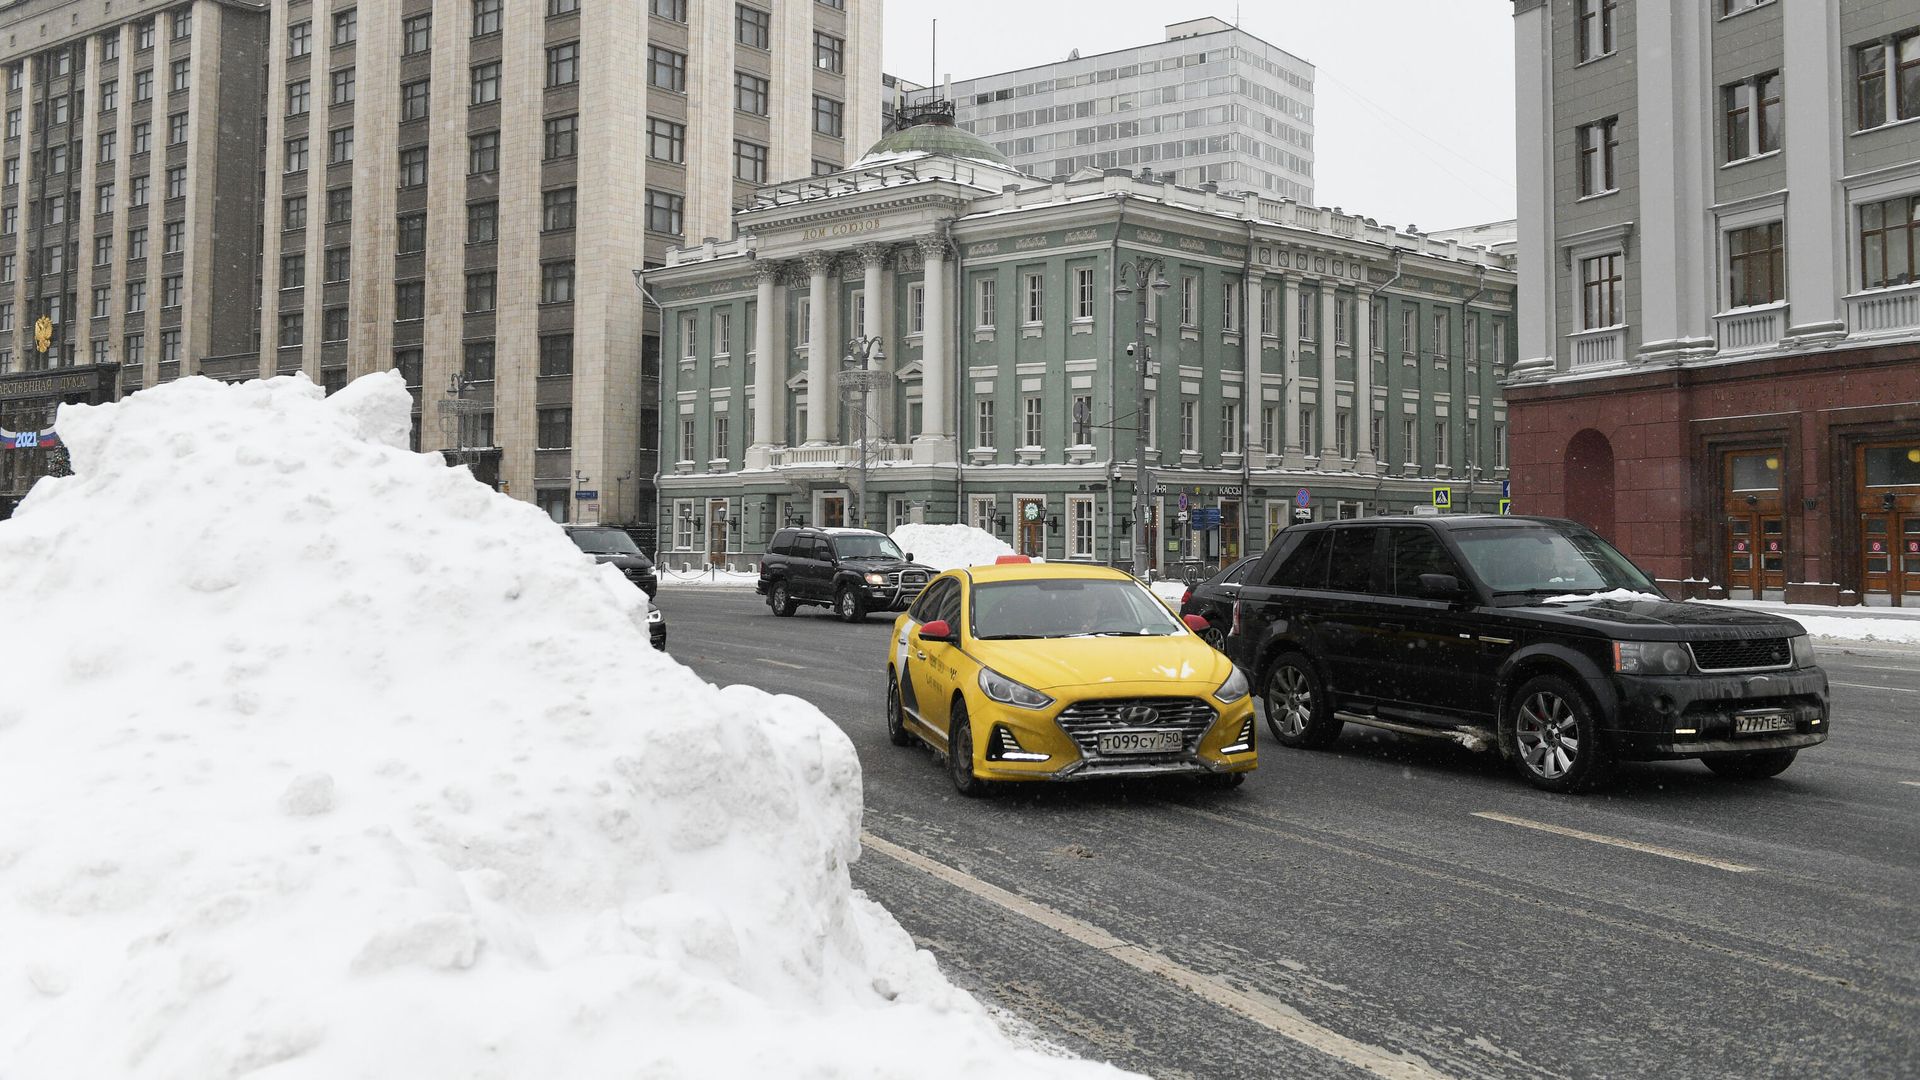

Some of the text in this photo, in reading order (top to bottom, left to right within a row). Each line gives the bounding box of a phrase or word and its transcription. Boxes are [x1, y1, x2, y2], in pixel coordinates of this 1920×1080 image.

[803, 219, 880, 240] ДОМ СОЮЗОВ
[15, 432, 38, 448] 2021
[1219, 487, 1242, 496] КАССЫ
[1159, 732, 1179, 744] 750
